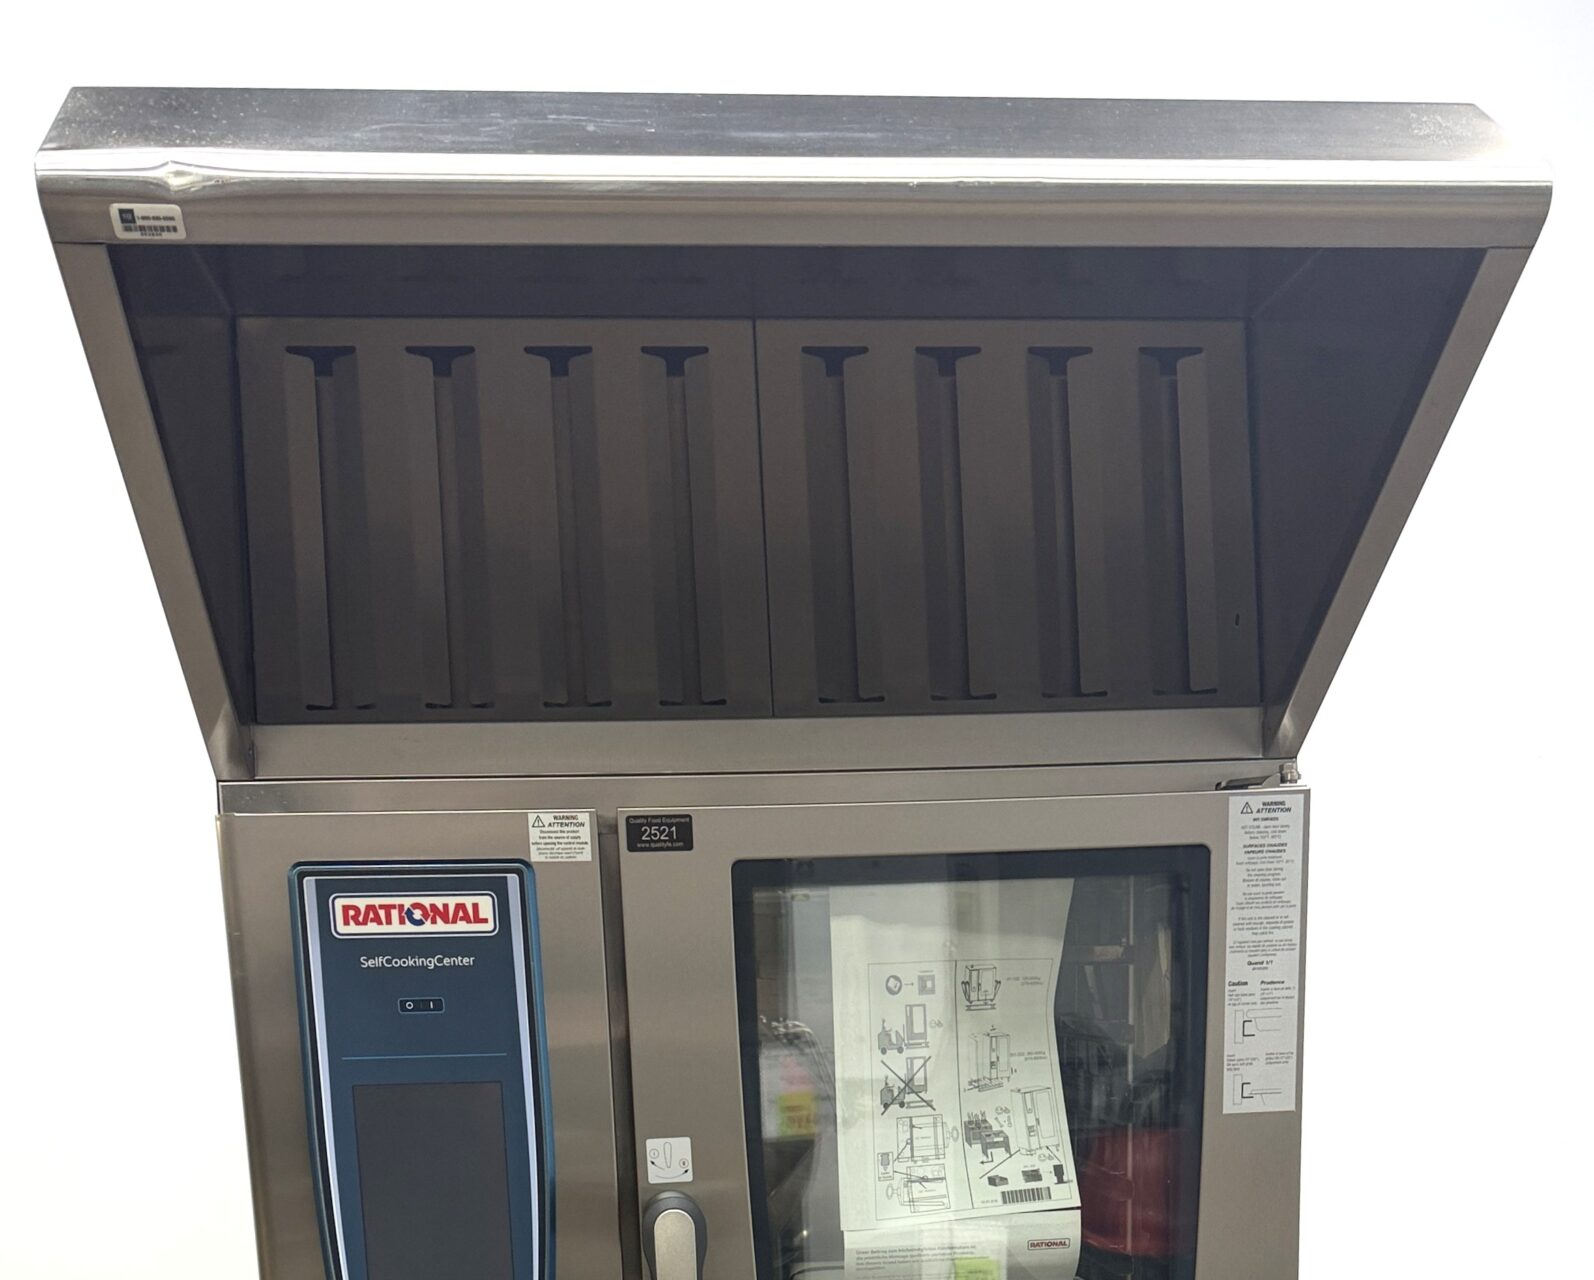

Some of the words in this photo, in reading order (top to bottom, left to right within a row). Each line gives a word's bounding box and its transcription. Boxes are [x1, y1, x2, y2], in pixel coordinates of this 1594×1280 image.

[641, 826, 677, 840] 2521
[342, 902, 488, 926] RATIONAL
[360, 955, 475, 969] SelfCookingCenter
